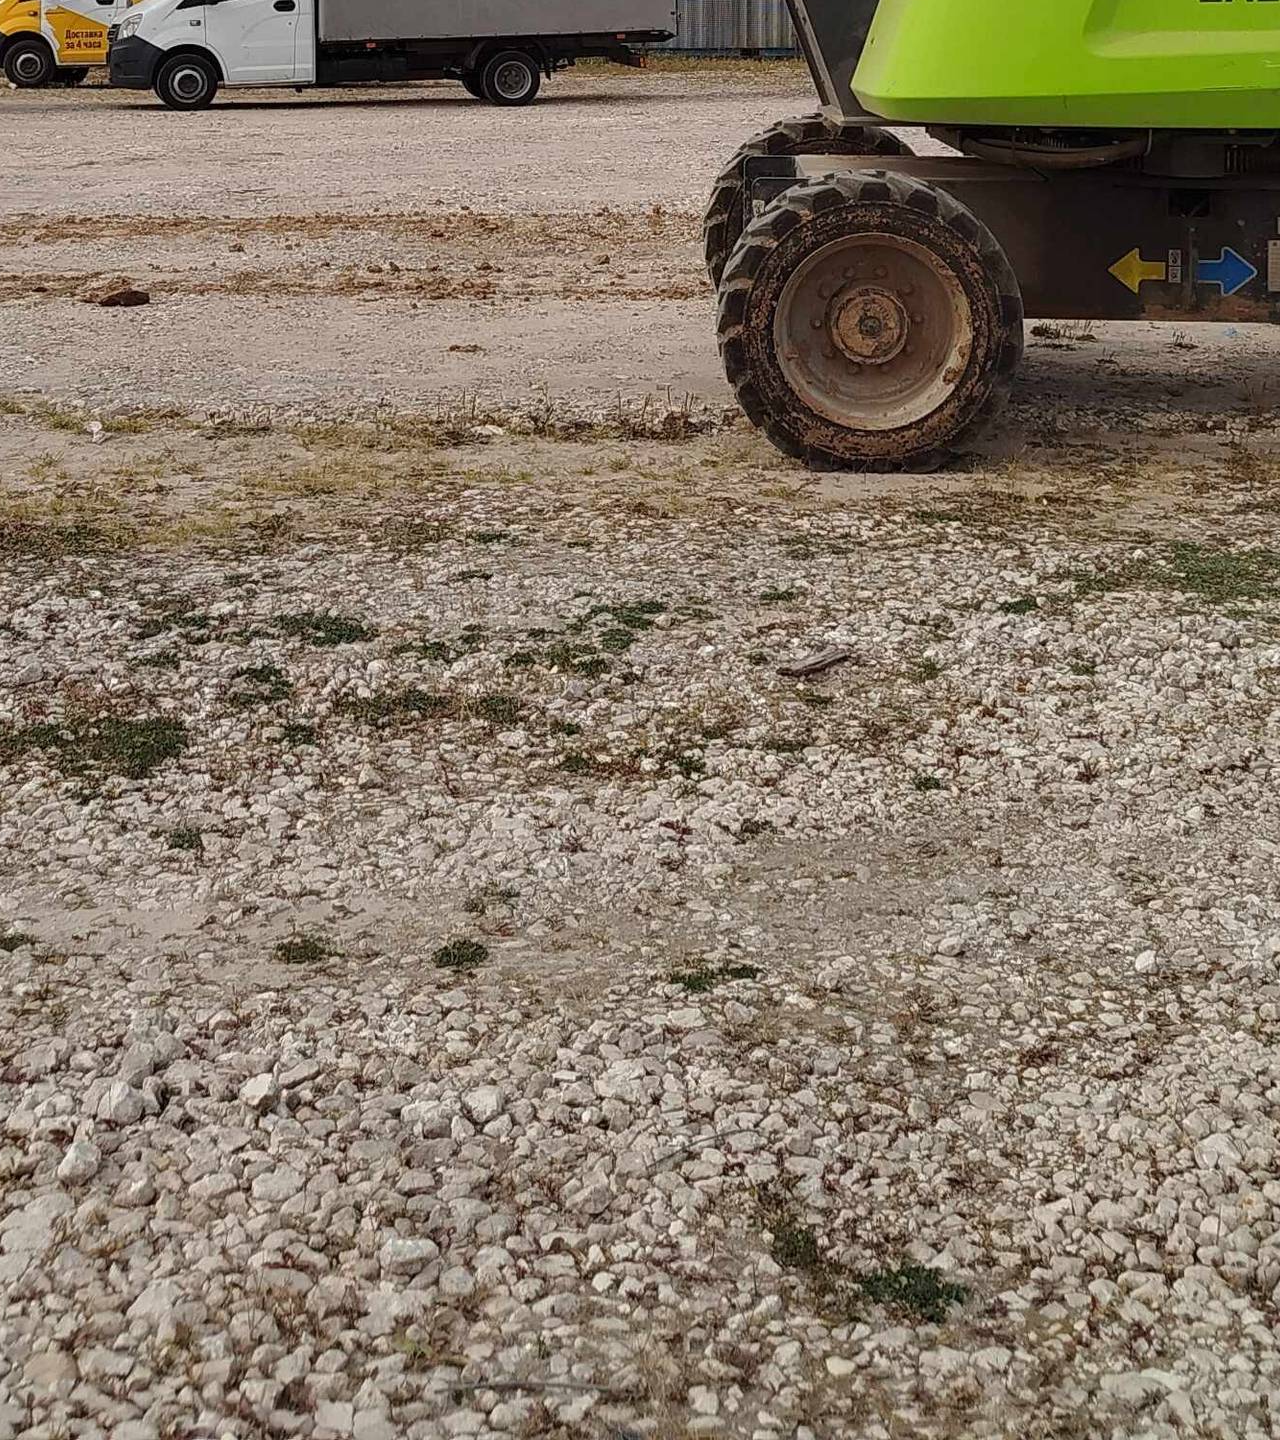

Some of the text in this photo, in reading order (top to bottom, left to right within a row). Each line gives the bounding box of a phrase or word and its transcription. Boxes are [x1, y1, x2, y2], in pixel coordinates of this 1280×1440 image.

[65, 29, 103, 40] Доставка
[65, 39, 102, 49] за 4 часа
